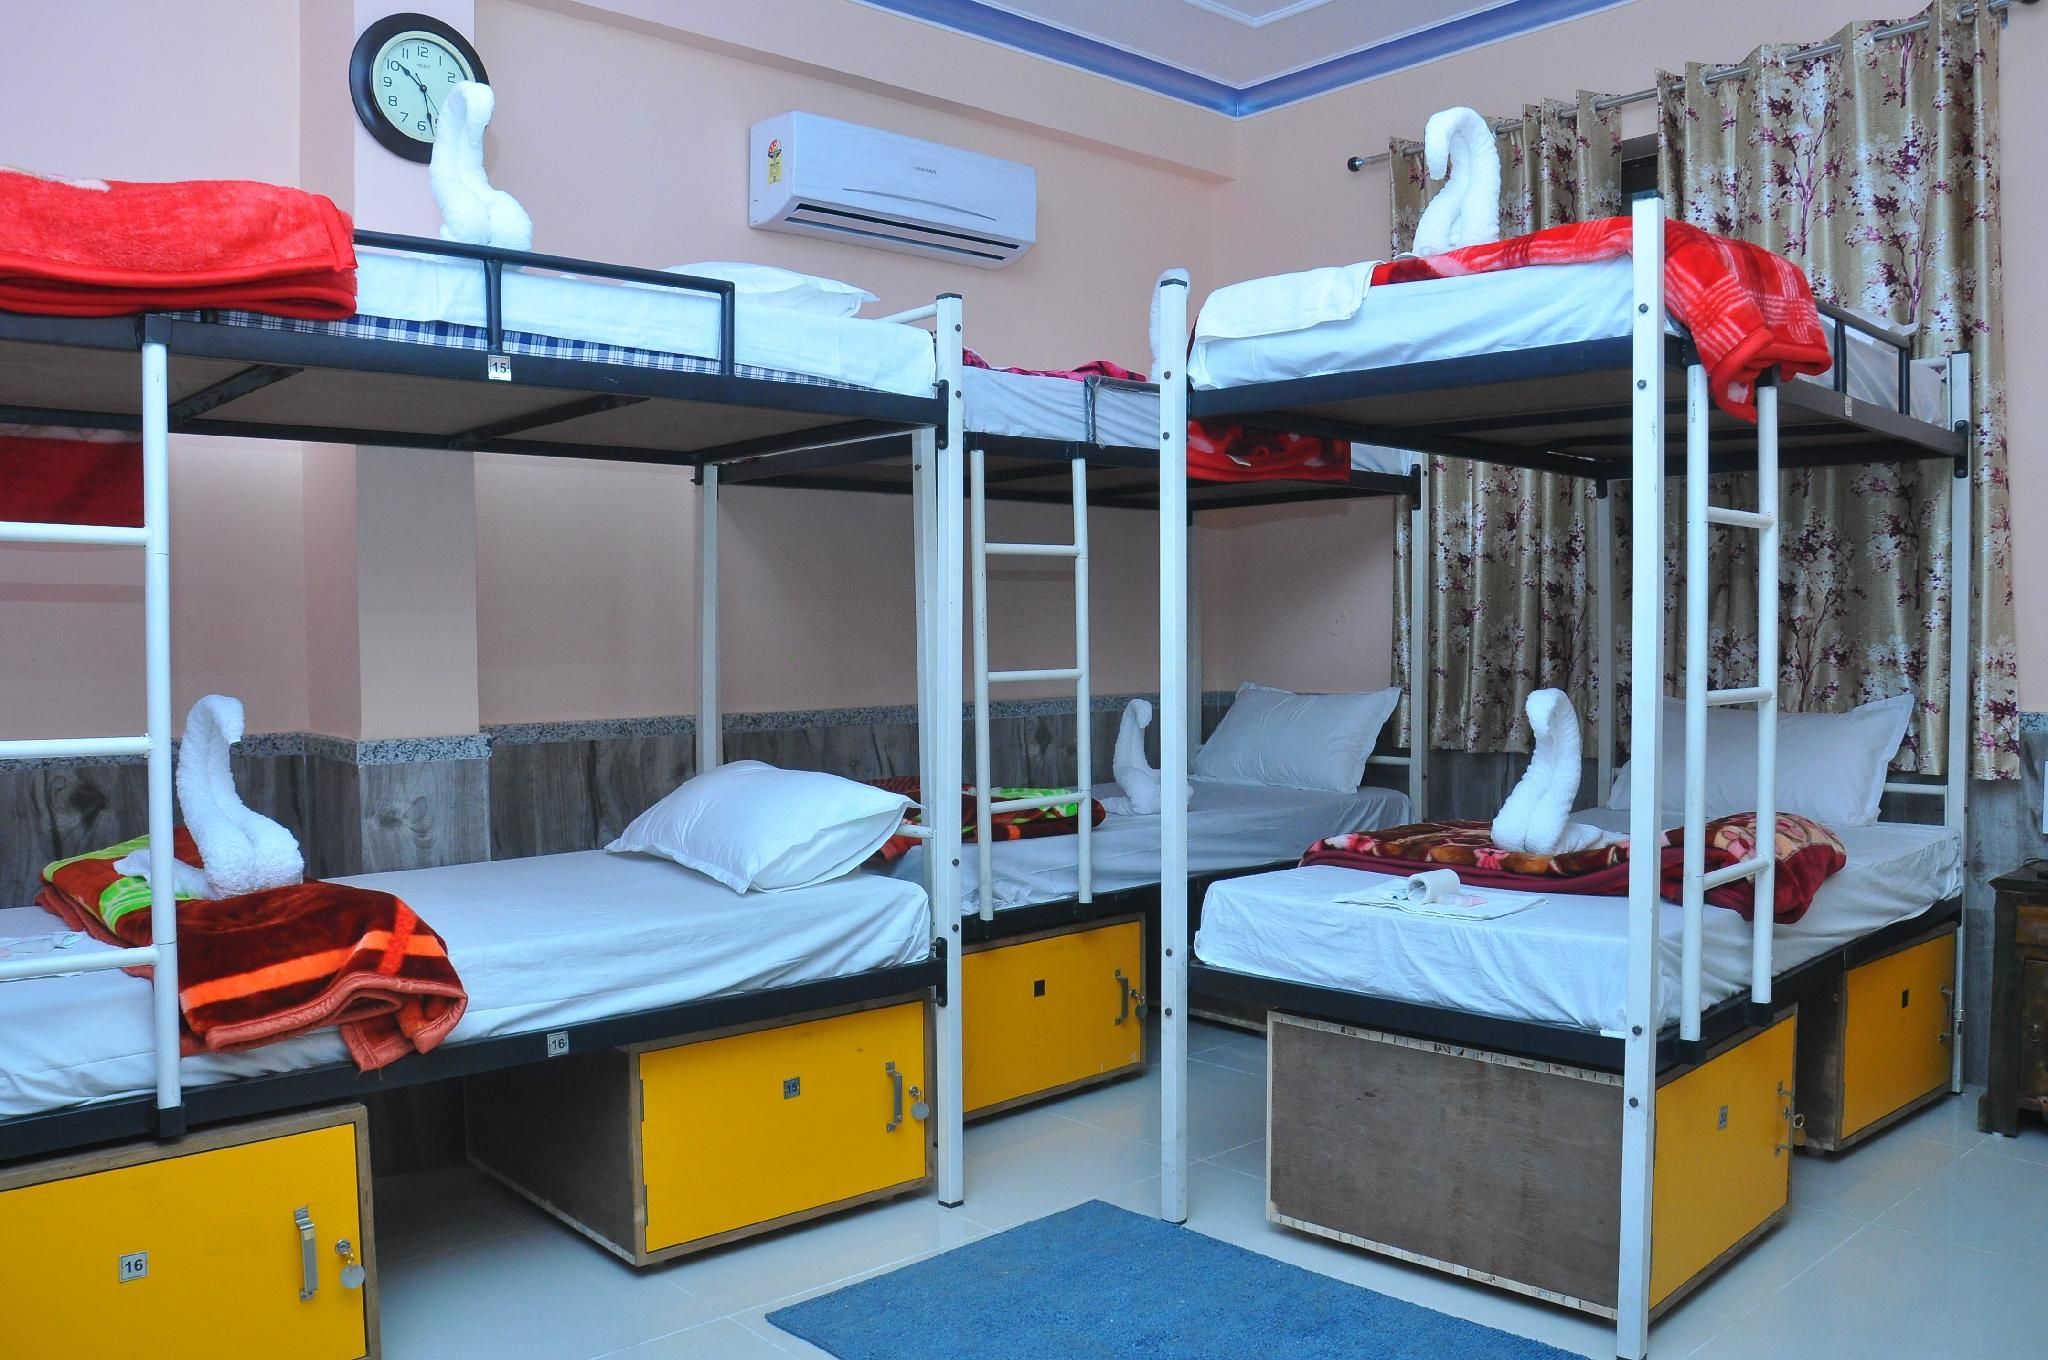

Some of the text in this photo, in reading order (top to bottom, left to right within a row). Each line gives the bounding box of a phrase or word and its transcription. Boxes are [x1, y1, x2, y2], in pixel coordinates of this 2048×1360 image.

[402, 48, 409, 59] 11
[417, 45, 429, 58] 12
[387, 59, 400, 71] 10
[383, 77, 392, 88] 9
[447, 72, 456, 83] 2
[388, 96, 398, 107] 8
[400, 112, 409, 123] 7
[417, 120, 427, 131] 6
[492, 361, 507, 374] 15
[552, 1038, 565, 1050] 16
[125, 1258, 143, 1274] 16
